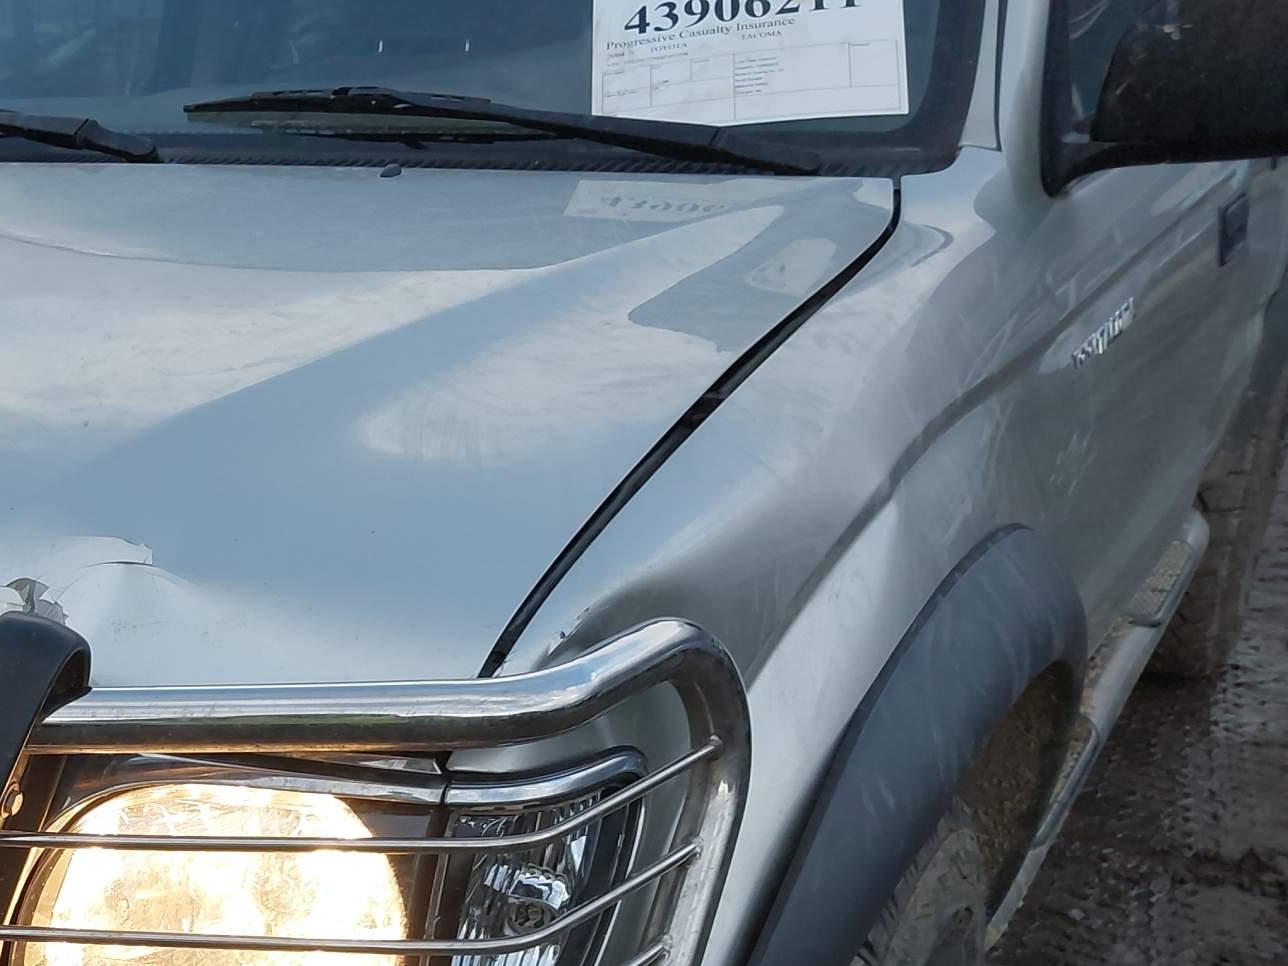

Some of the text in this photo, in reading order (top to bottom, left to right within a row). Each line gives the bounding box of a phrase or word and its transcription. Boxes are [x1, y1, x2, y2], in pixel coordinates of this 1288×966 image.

[623, 0, 863, 34] 439062
[606, 18, 796, 50] Progressive Casualty Insurance
